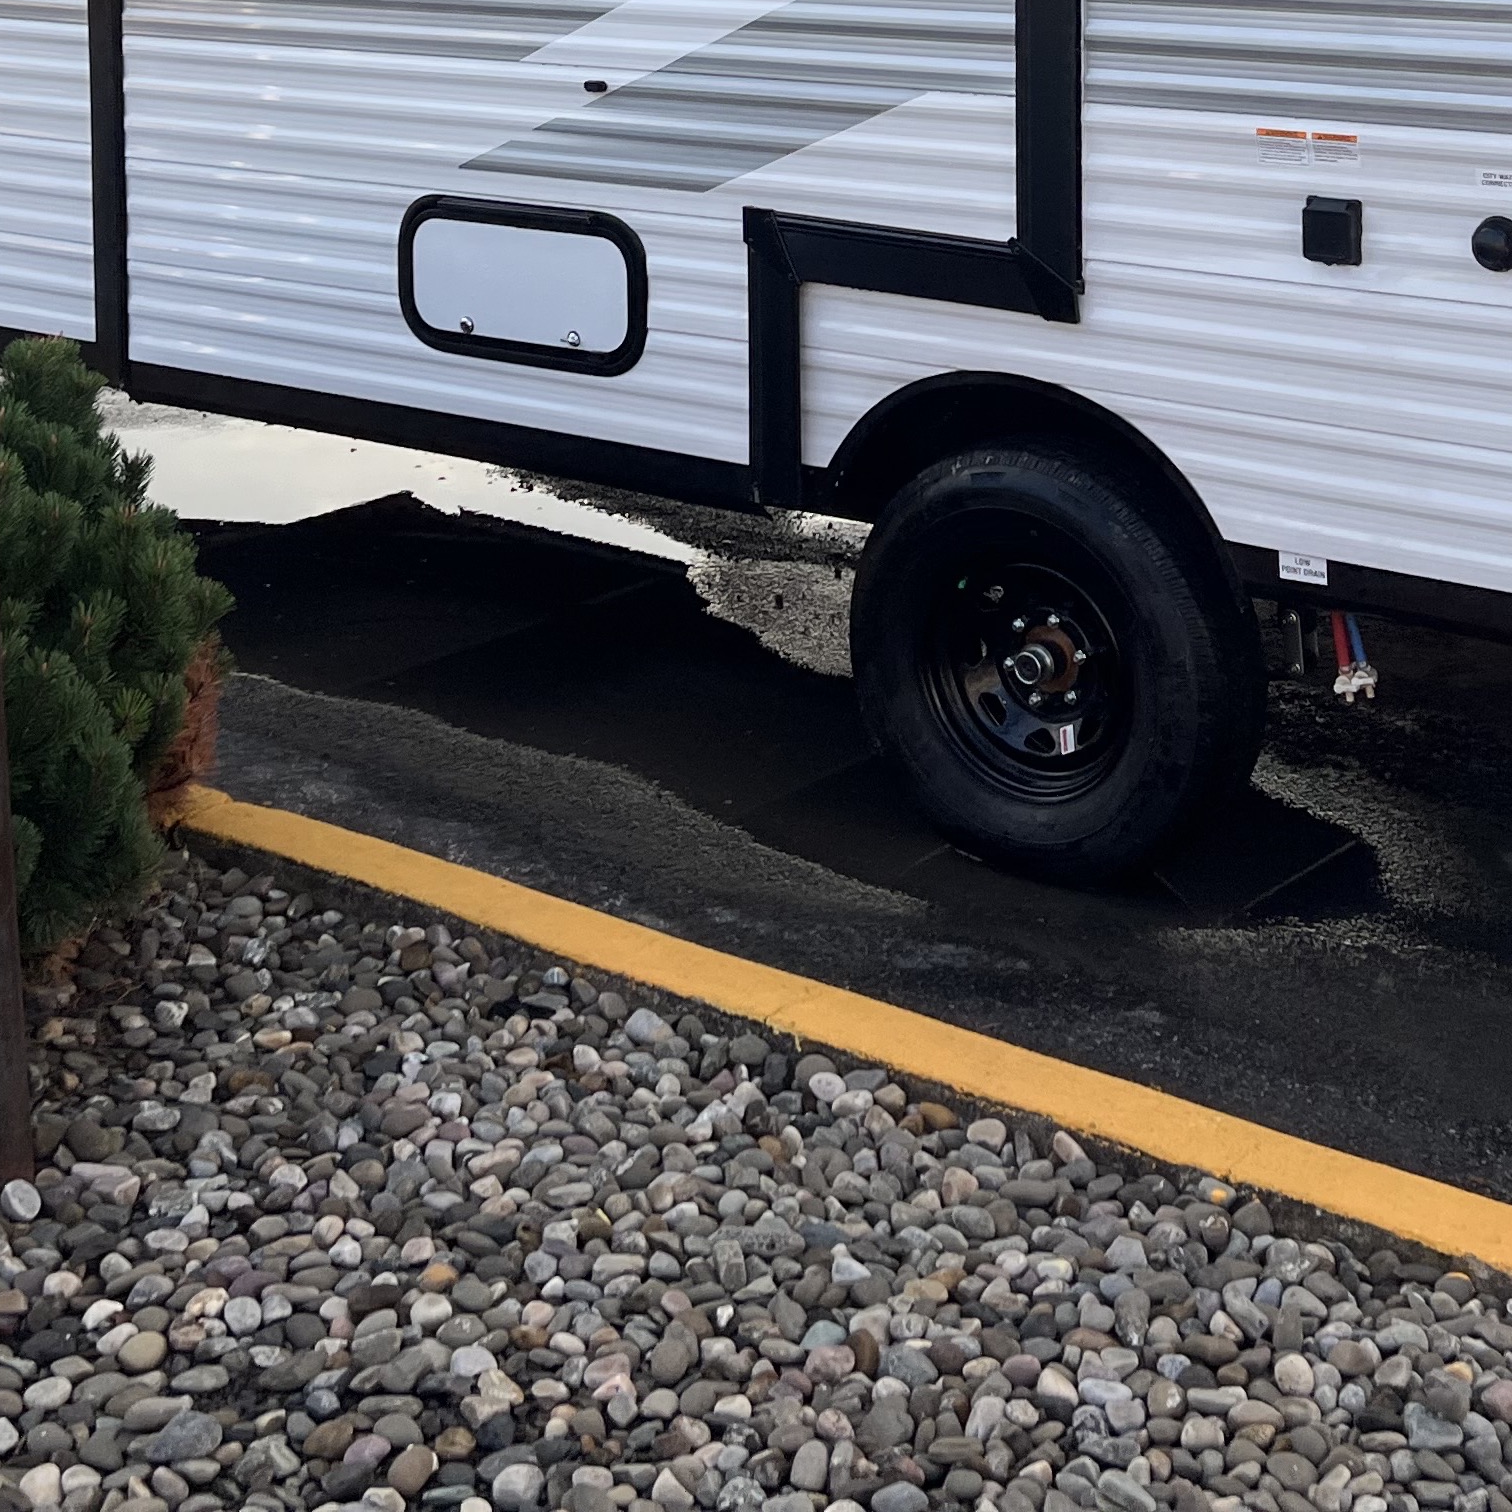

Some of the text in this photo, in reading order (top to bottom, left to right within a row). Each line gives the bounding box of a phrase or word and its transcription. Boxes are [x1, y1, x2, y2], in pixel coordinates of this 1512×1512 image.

[1293, 556, 1311, 567] LOW
[1281, 564, 1326, 579] POINT DRAIN
